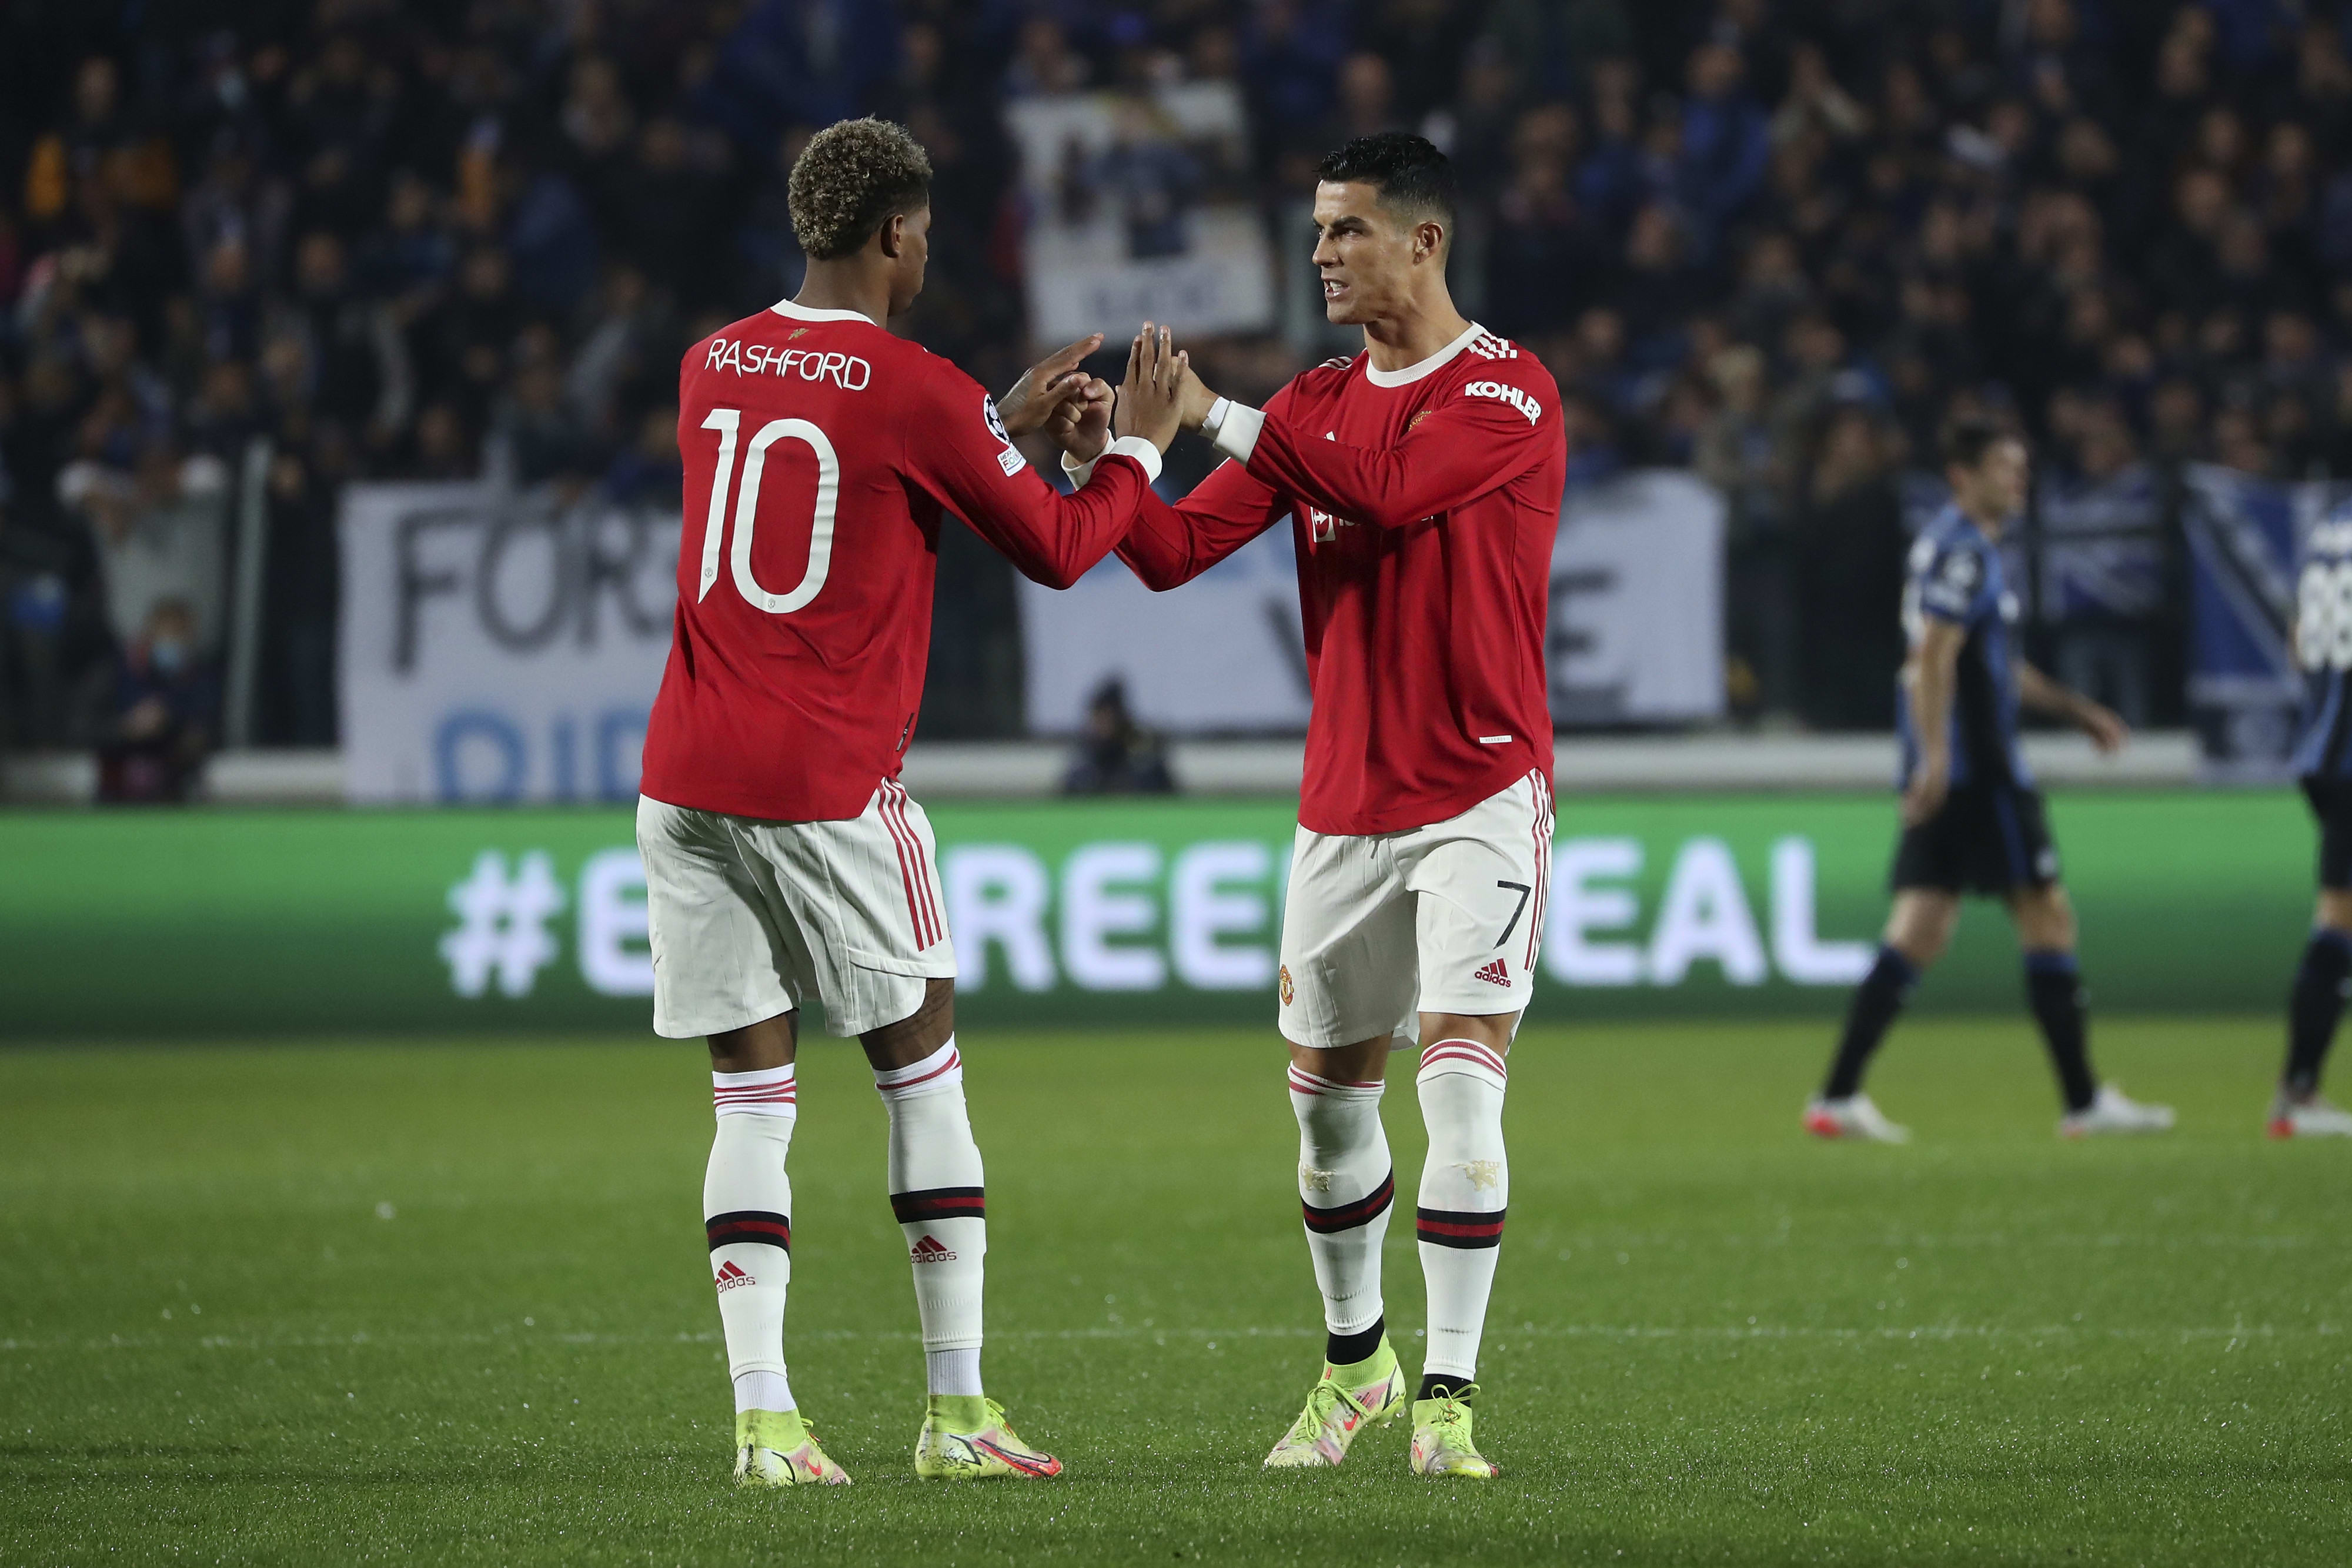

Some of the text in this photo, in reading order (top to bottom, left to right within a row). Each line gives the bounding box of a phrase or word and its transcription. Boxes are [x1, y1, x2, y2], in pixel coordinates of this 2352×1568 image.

[704, 339, 871, 391] RASHFORD
[1465, 381, 1542, 426] KOHLER
[698, 408, 840, 614] 10
[390, 504, 682, 677] FOR
[1497, 880, 1531, 950] 7
[1474, 971, 1511, 988] adidas
[910, 1251, 957, 1263] adidas
[717, 1276, 756, 1293] didas
